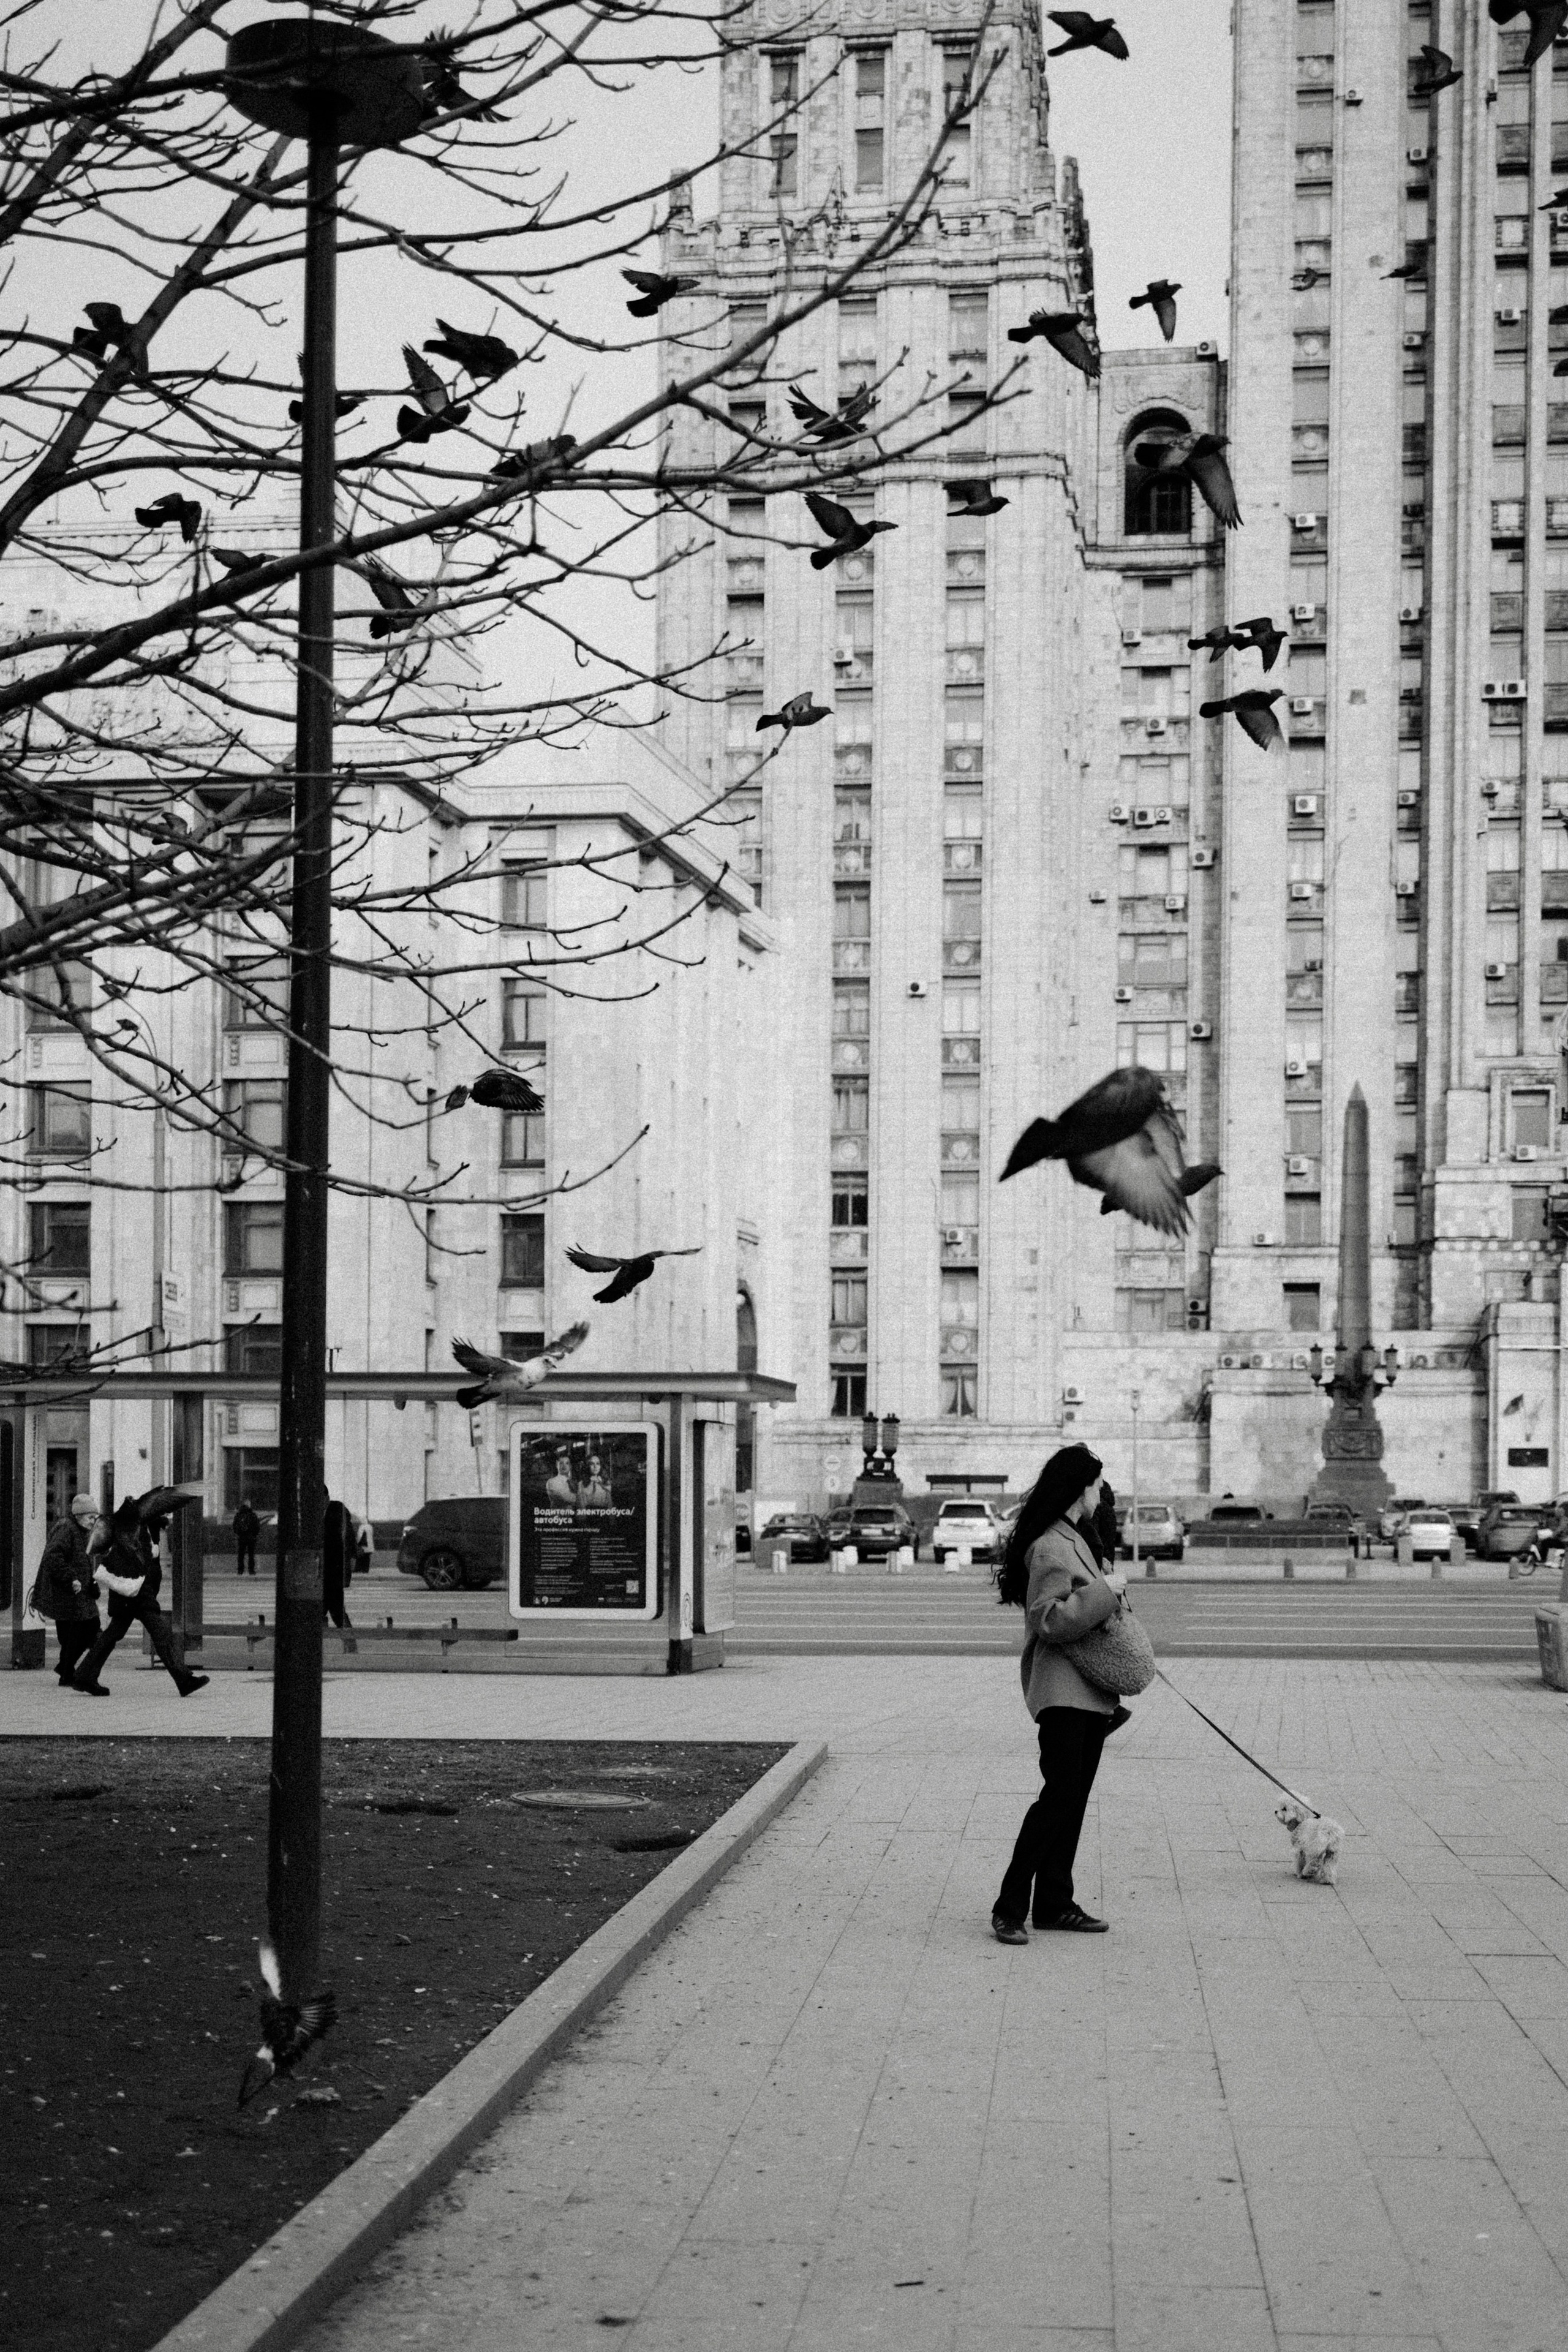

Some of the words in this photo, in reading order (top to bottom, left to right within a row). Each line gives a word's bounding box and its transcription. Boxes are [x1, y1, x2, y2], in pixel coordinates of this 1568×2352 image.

[534, 1507, 575, 1516] Водитель
[576, 1506, 635, 1517] электробуса/
[534, 1515, 573, 1525] автобуса
